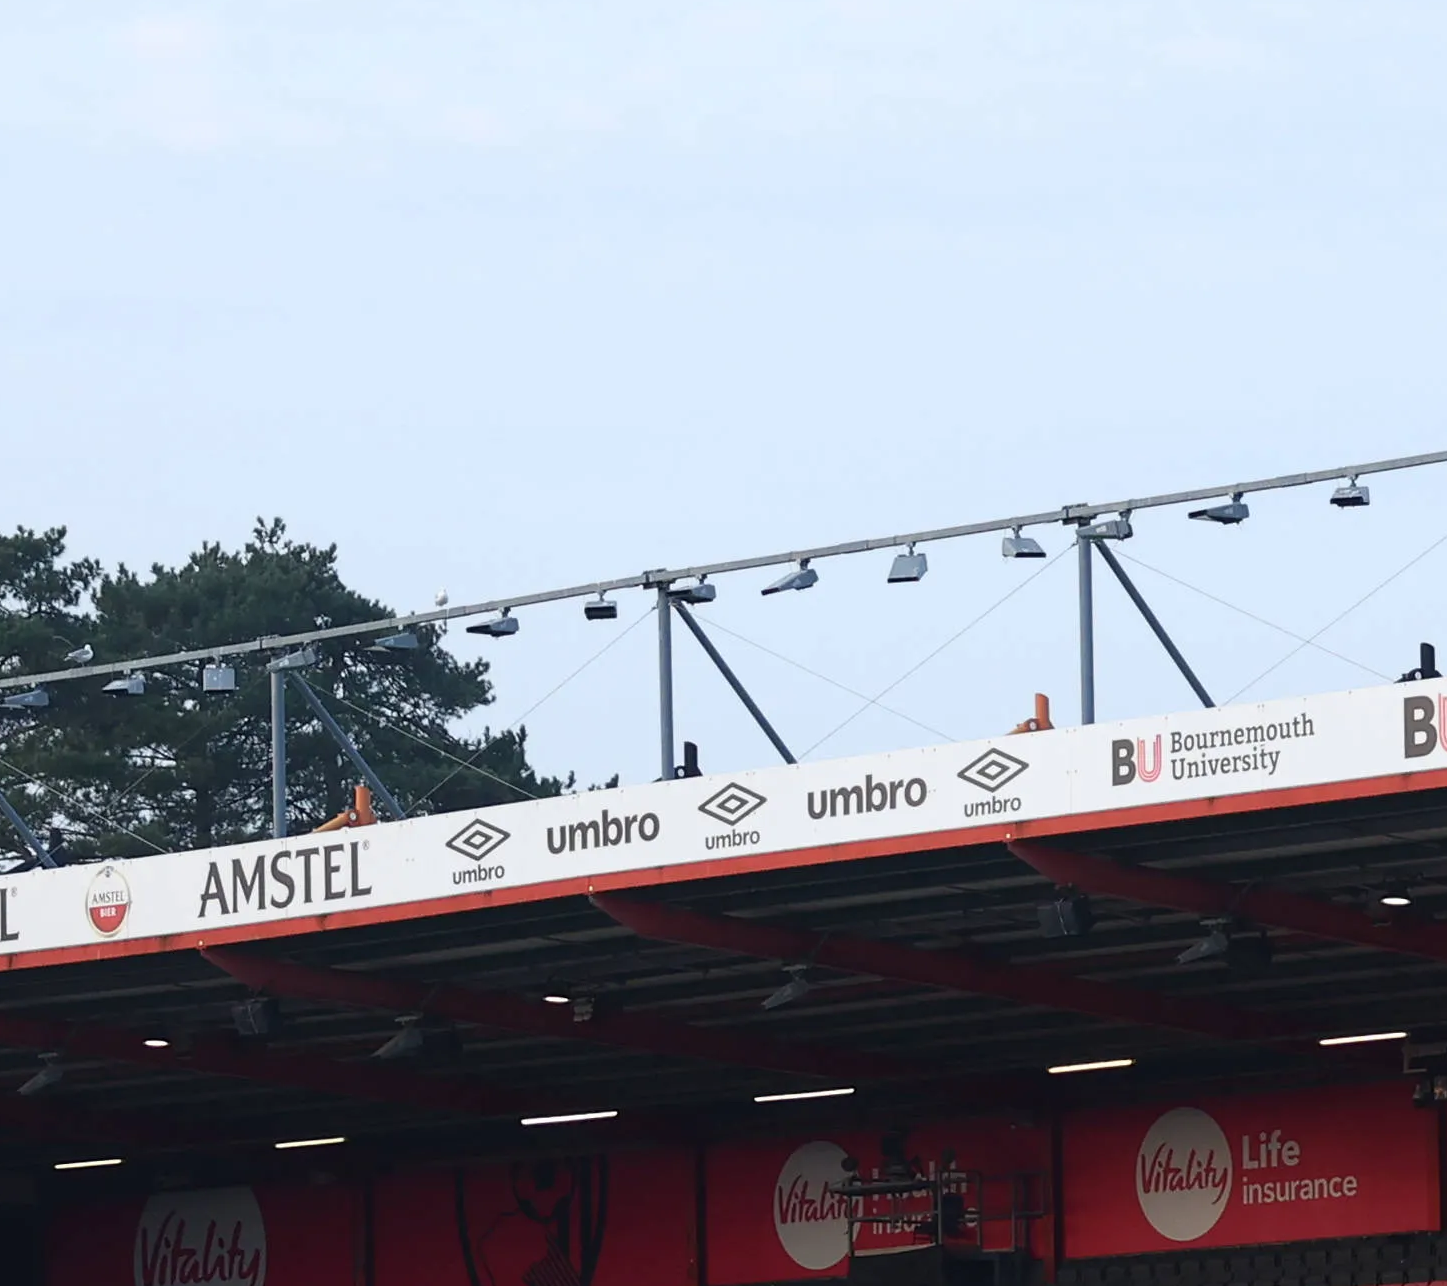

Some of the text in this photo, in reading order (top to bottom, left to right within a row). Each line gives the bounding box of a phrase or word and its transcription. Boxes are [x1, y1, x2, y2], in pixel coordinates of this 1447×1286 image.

[1112, 715, 1316, 787] BU Bournemouth
[1170, 747, 1281, 781] University
[807, 775, 928, 820] umbro
[963, 794, 1022, 818] umbro
[546, 811, 660, 855] umbro
[705, 828, 760, 851] umbro
[198, 842, 372, 918] AMSTEL
[452, 863, 506, 885] umbro
[92, 891, 125, 904] AMSTEL
[100, 907, 117, 918] BIER
[1242, 1130, 1301, 1170] Life
[1141, 1142, 1228, 1205] Vitality
[1242, 1175, 1358, 1205] insurance
